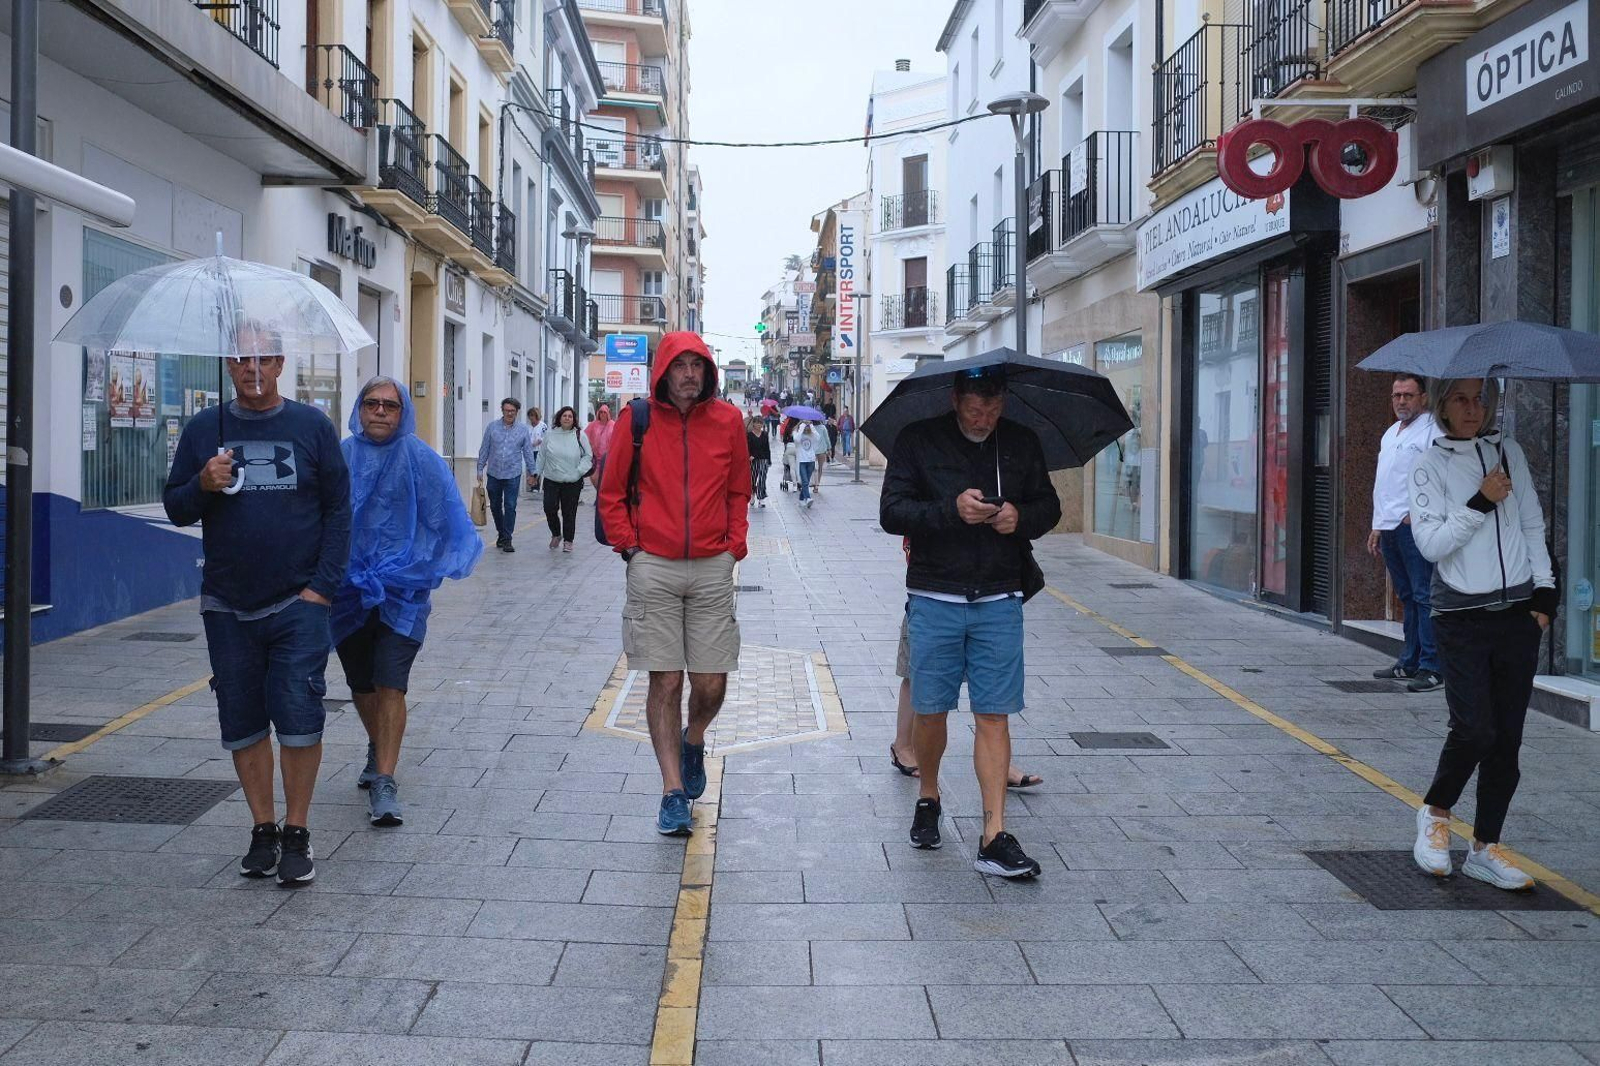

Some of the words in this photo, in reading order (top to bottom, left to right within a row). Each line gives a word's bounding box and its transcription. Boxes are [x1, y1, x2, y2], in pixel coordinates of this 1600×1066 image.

[1477, 21, 1577, 101] ÓPTICA
[1555, 80, 1583, 100] GALINDO
[1145, 223, 1164, 255] PIEL
[840, 224, 854, 331] INTERSPORT
